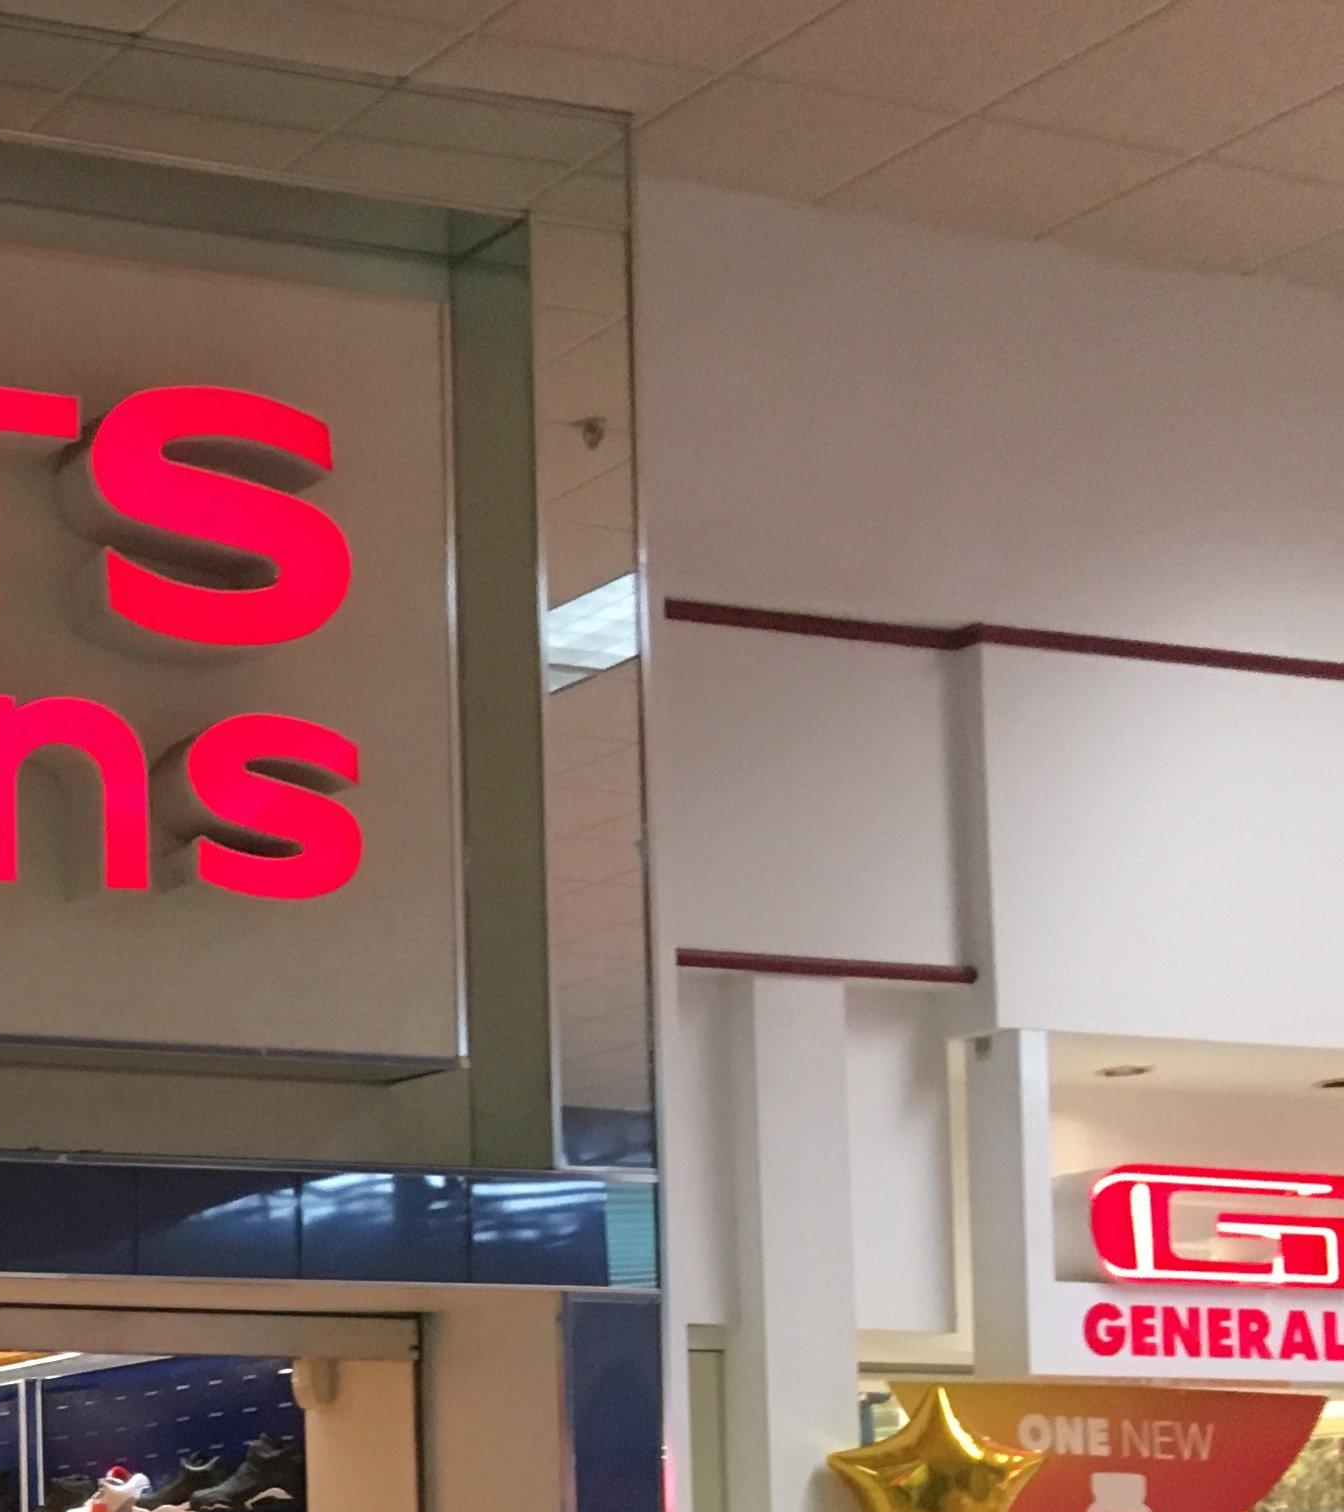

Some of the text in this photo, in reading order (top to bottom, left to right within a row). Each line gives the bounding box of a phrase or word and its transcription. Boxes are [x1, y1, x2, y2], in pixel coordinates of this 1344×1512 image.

[1084, 1302, 1344, 1361] GENERAL
[1017, 1413, 1214, 1461] ONE NEW
